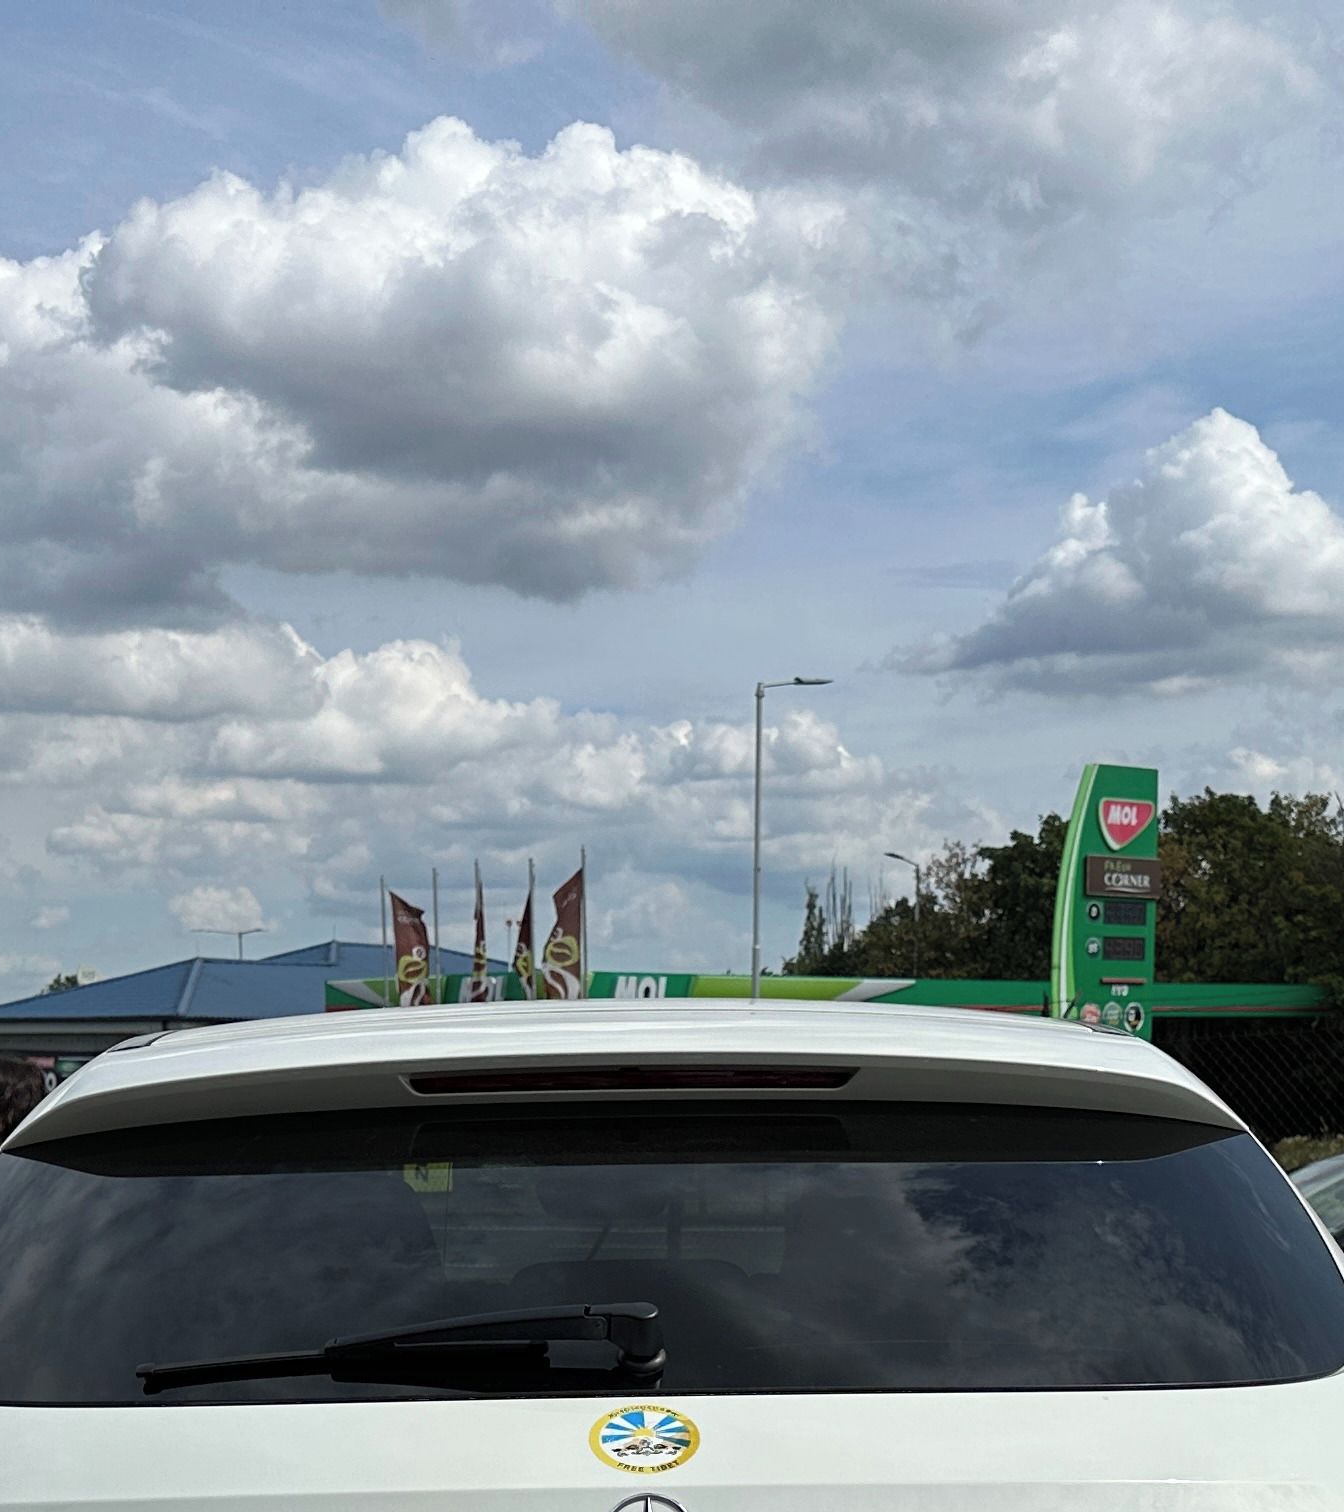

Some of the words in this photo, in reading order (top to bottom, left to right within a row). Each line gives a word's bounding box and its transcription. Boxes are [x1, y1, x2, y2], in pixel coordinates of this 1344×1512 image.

[1107, 805, 1139, 826] MOL
[1103, 873, 1151, 888] CORNER
[617, 1462, 645, 1473] FREE
[650, 1460, 681, 1472] TIBET
